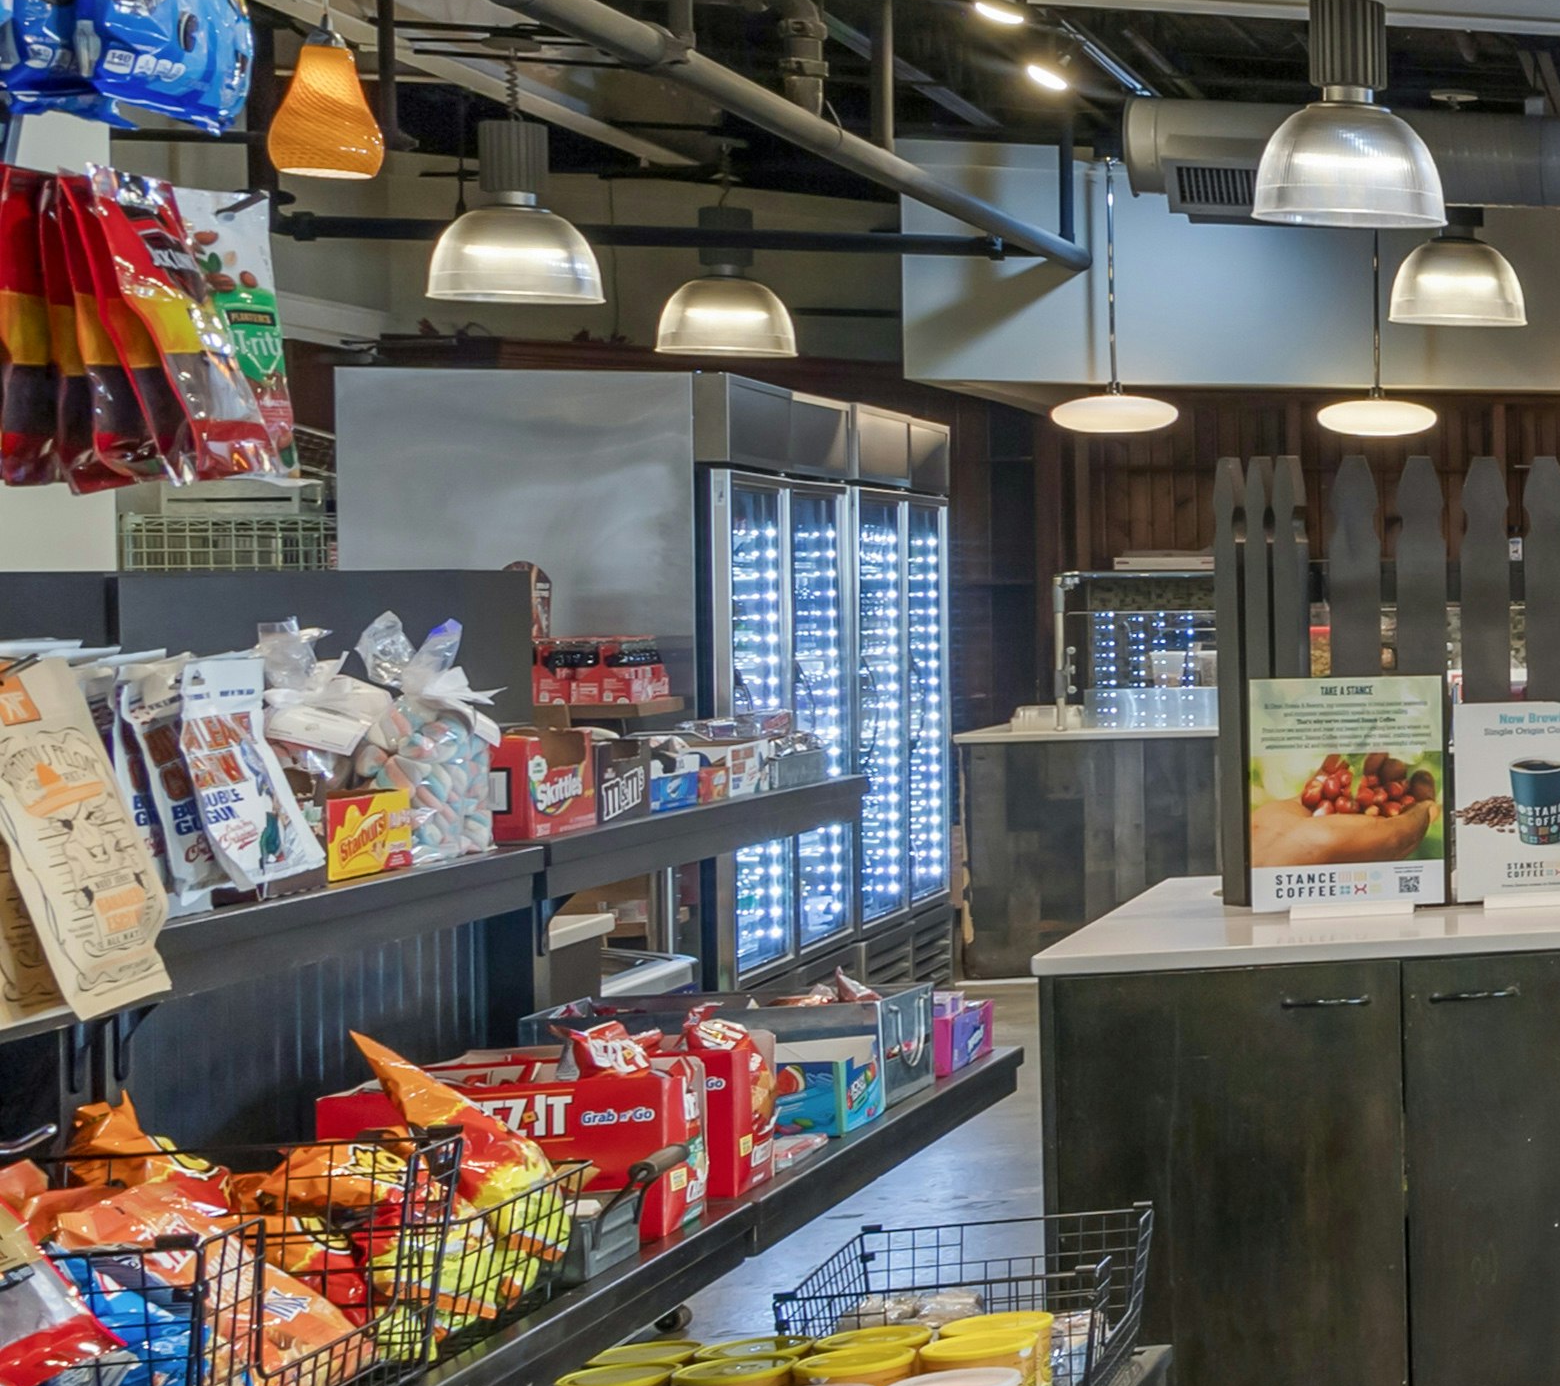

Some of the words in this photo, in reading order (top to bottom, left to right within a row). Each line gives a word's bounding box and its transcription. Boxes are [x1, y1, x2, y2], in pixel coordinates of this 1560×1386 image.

[1321, 686, 1338, 696] TAKE
[1340, 686, 1345, 695] A
[1348, 685, 1373, 695] STANCE
[1499, 714, 1525, 725] Now
[1484, 728, 1513, 736] Single
[1516, 727, 1545, 736] Origin
[536, 774, 583, 811] Skittles
[1507, 861, 1544, 870] STANCE
[1275, 872, 1337, 887] STANCE
[1507, 870, 1544, 878] COFFEE
[1275, 885, 1337, 899] COFFEE
[705, 1076, 726, 1090] Go
[580, 1110, 617, 1126] Grab
[633, 1107, 656, 1121] Go
